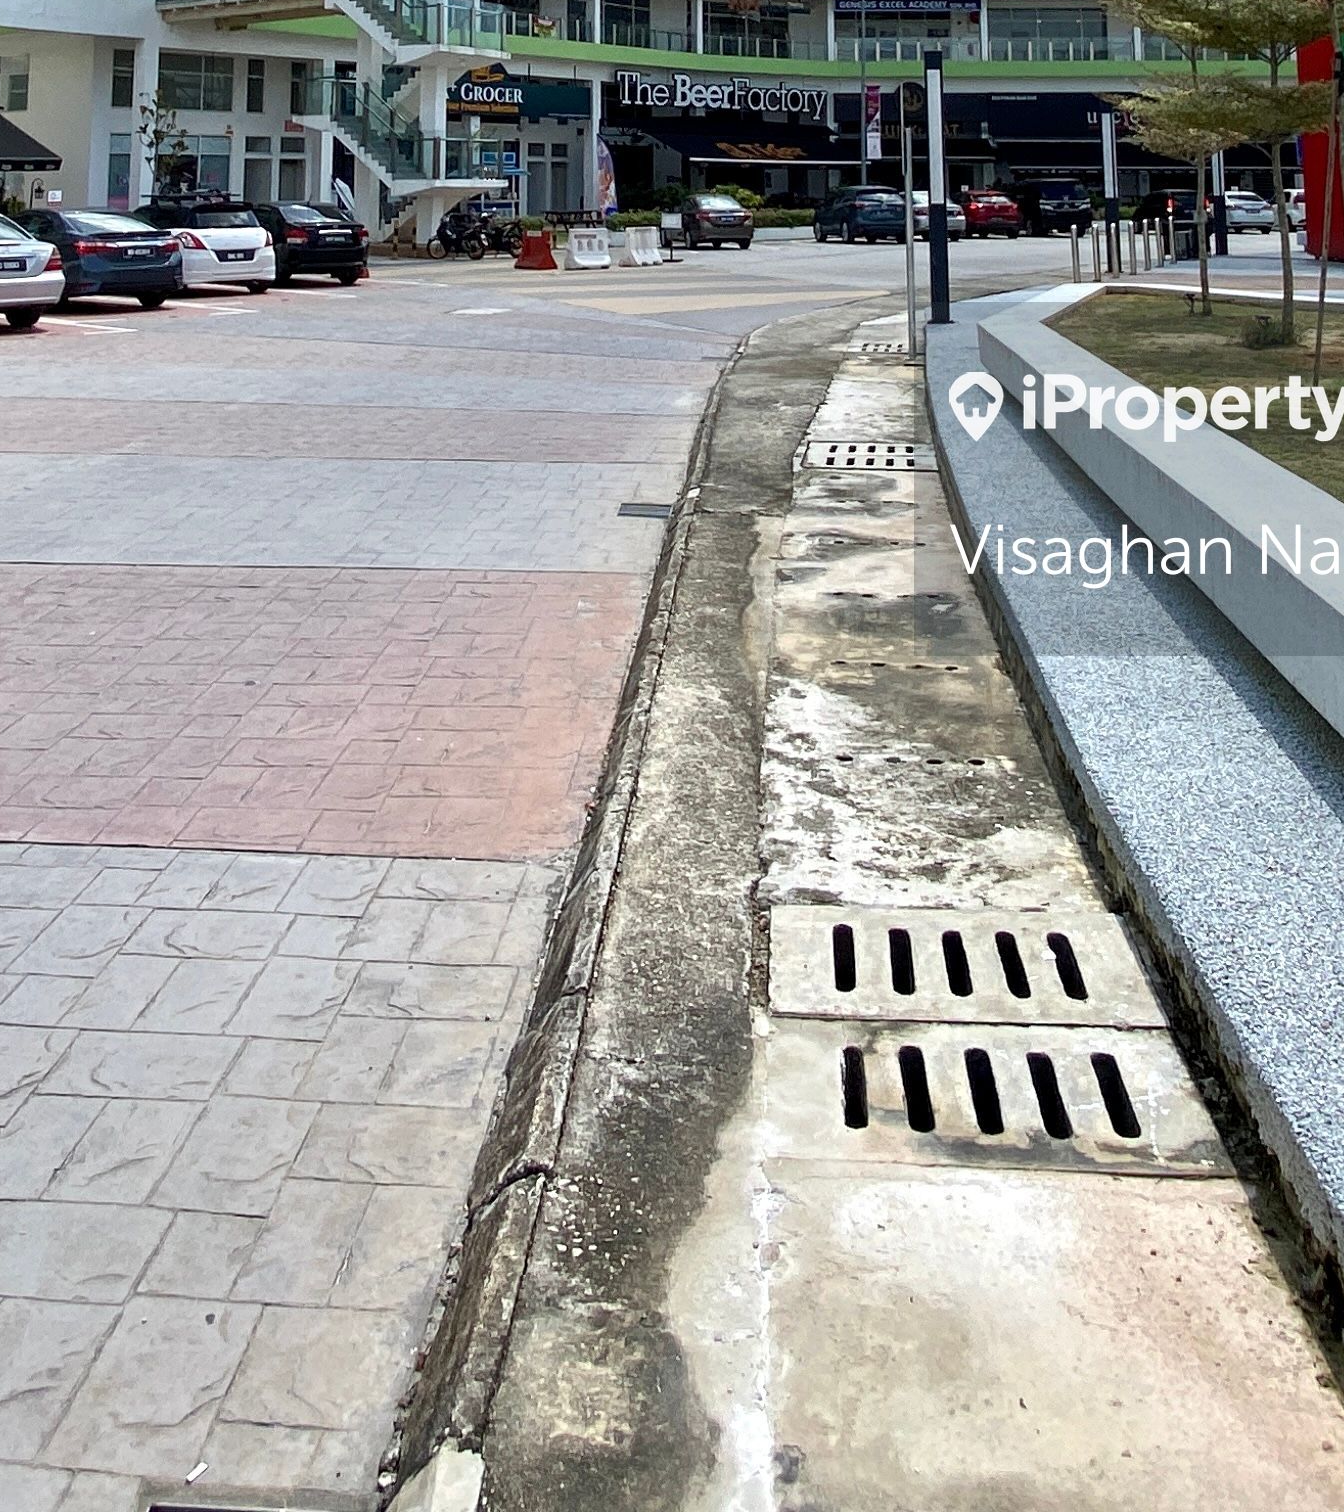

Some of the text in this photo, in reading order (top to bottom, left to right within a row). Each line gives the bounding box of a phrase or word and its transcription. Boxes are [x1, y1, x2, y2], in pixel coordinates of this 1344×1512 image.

[908, 0, 948, 9] ACADEMY
[460, 82, 524, 104] GROCER
[617, 71, 670, 106] The
